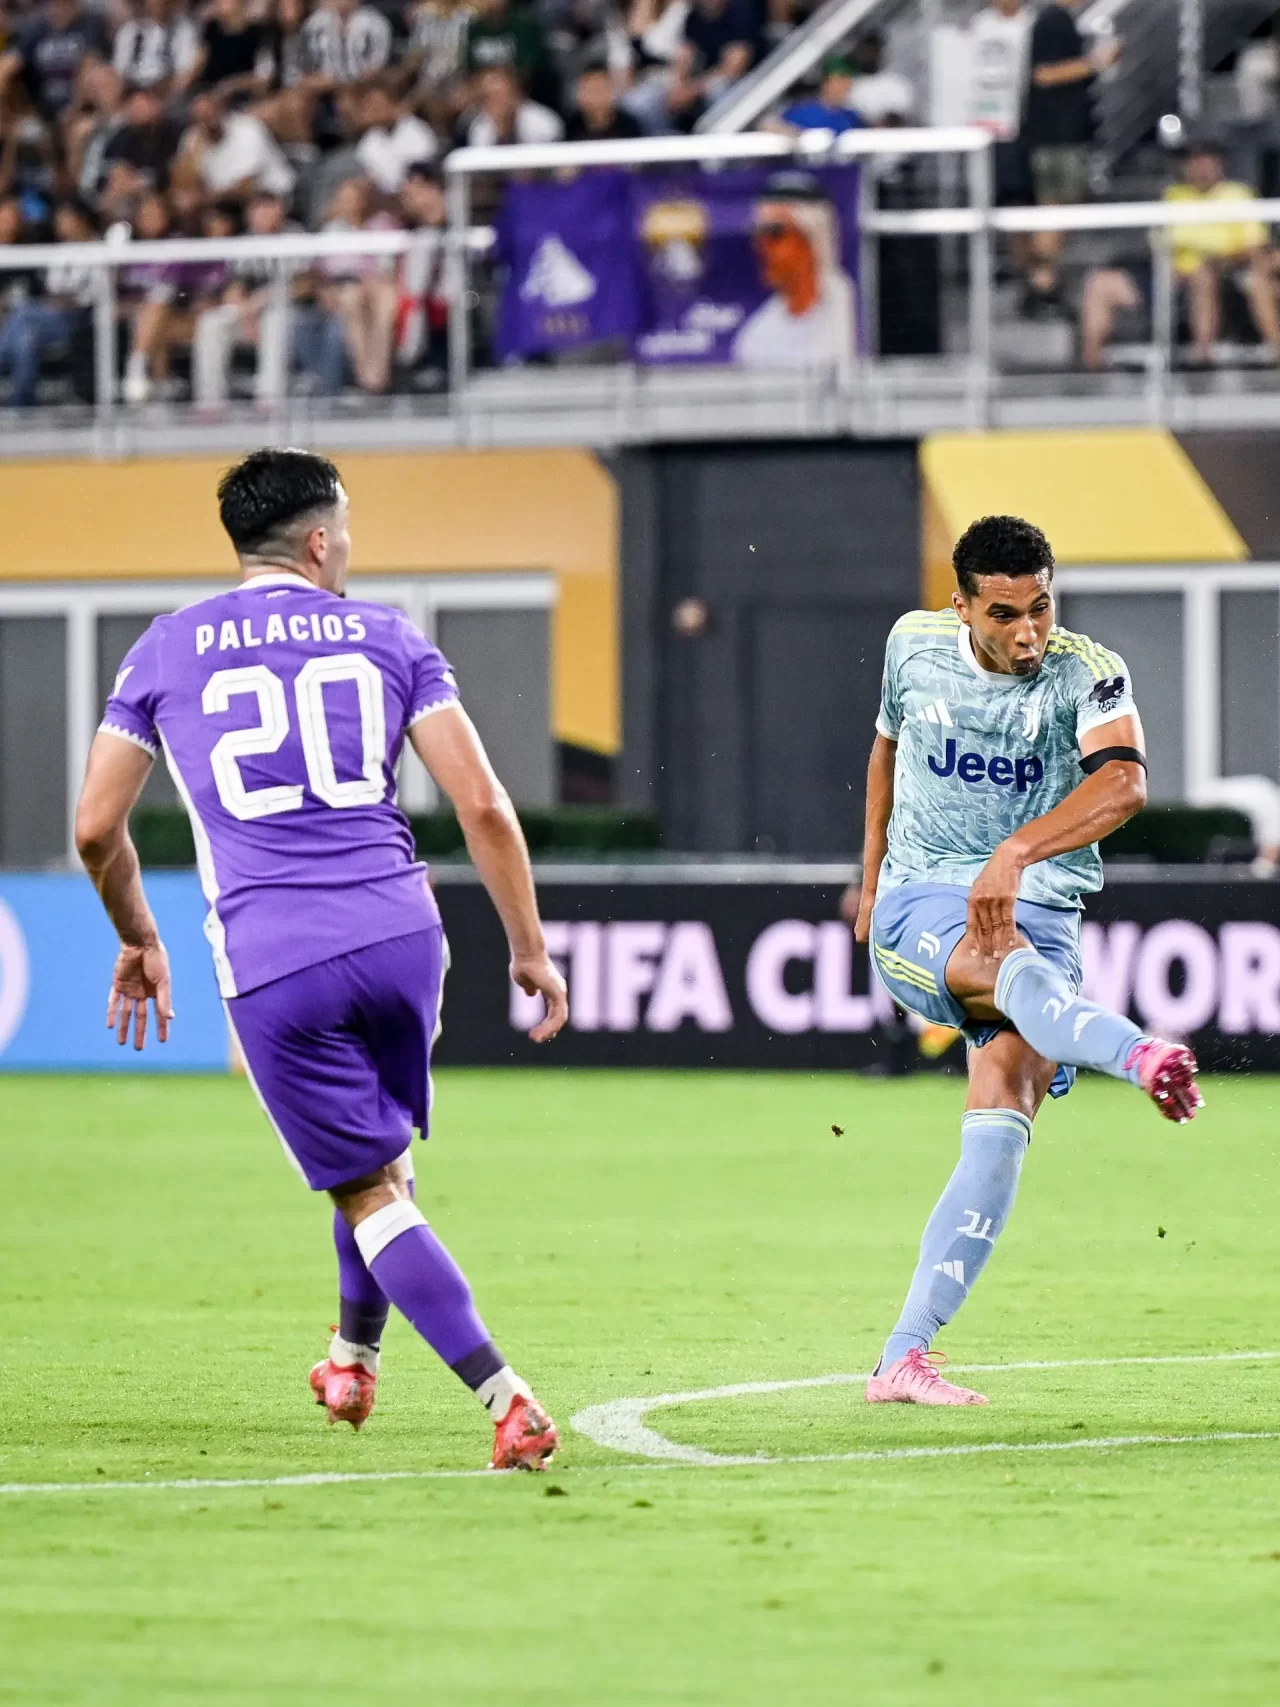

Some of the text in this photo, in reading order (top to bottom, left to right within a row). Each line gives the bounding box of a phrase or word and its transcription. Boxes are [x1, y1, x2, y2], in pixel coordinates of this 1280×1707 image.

[196, 613, 366, 655] PALACIOS
[202, 652, 387, 821] 20
[927, 738, 1043, 792] Jeep
